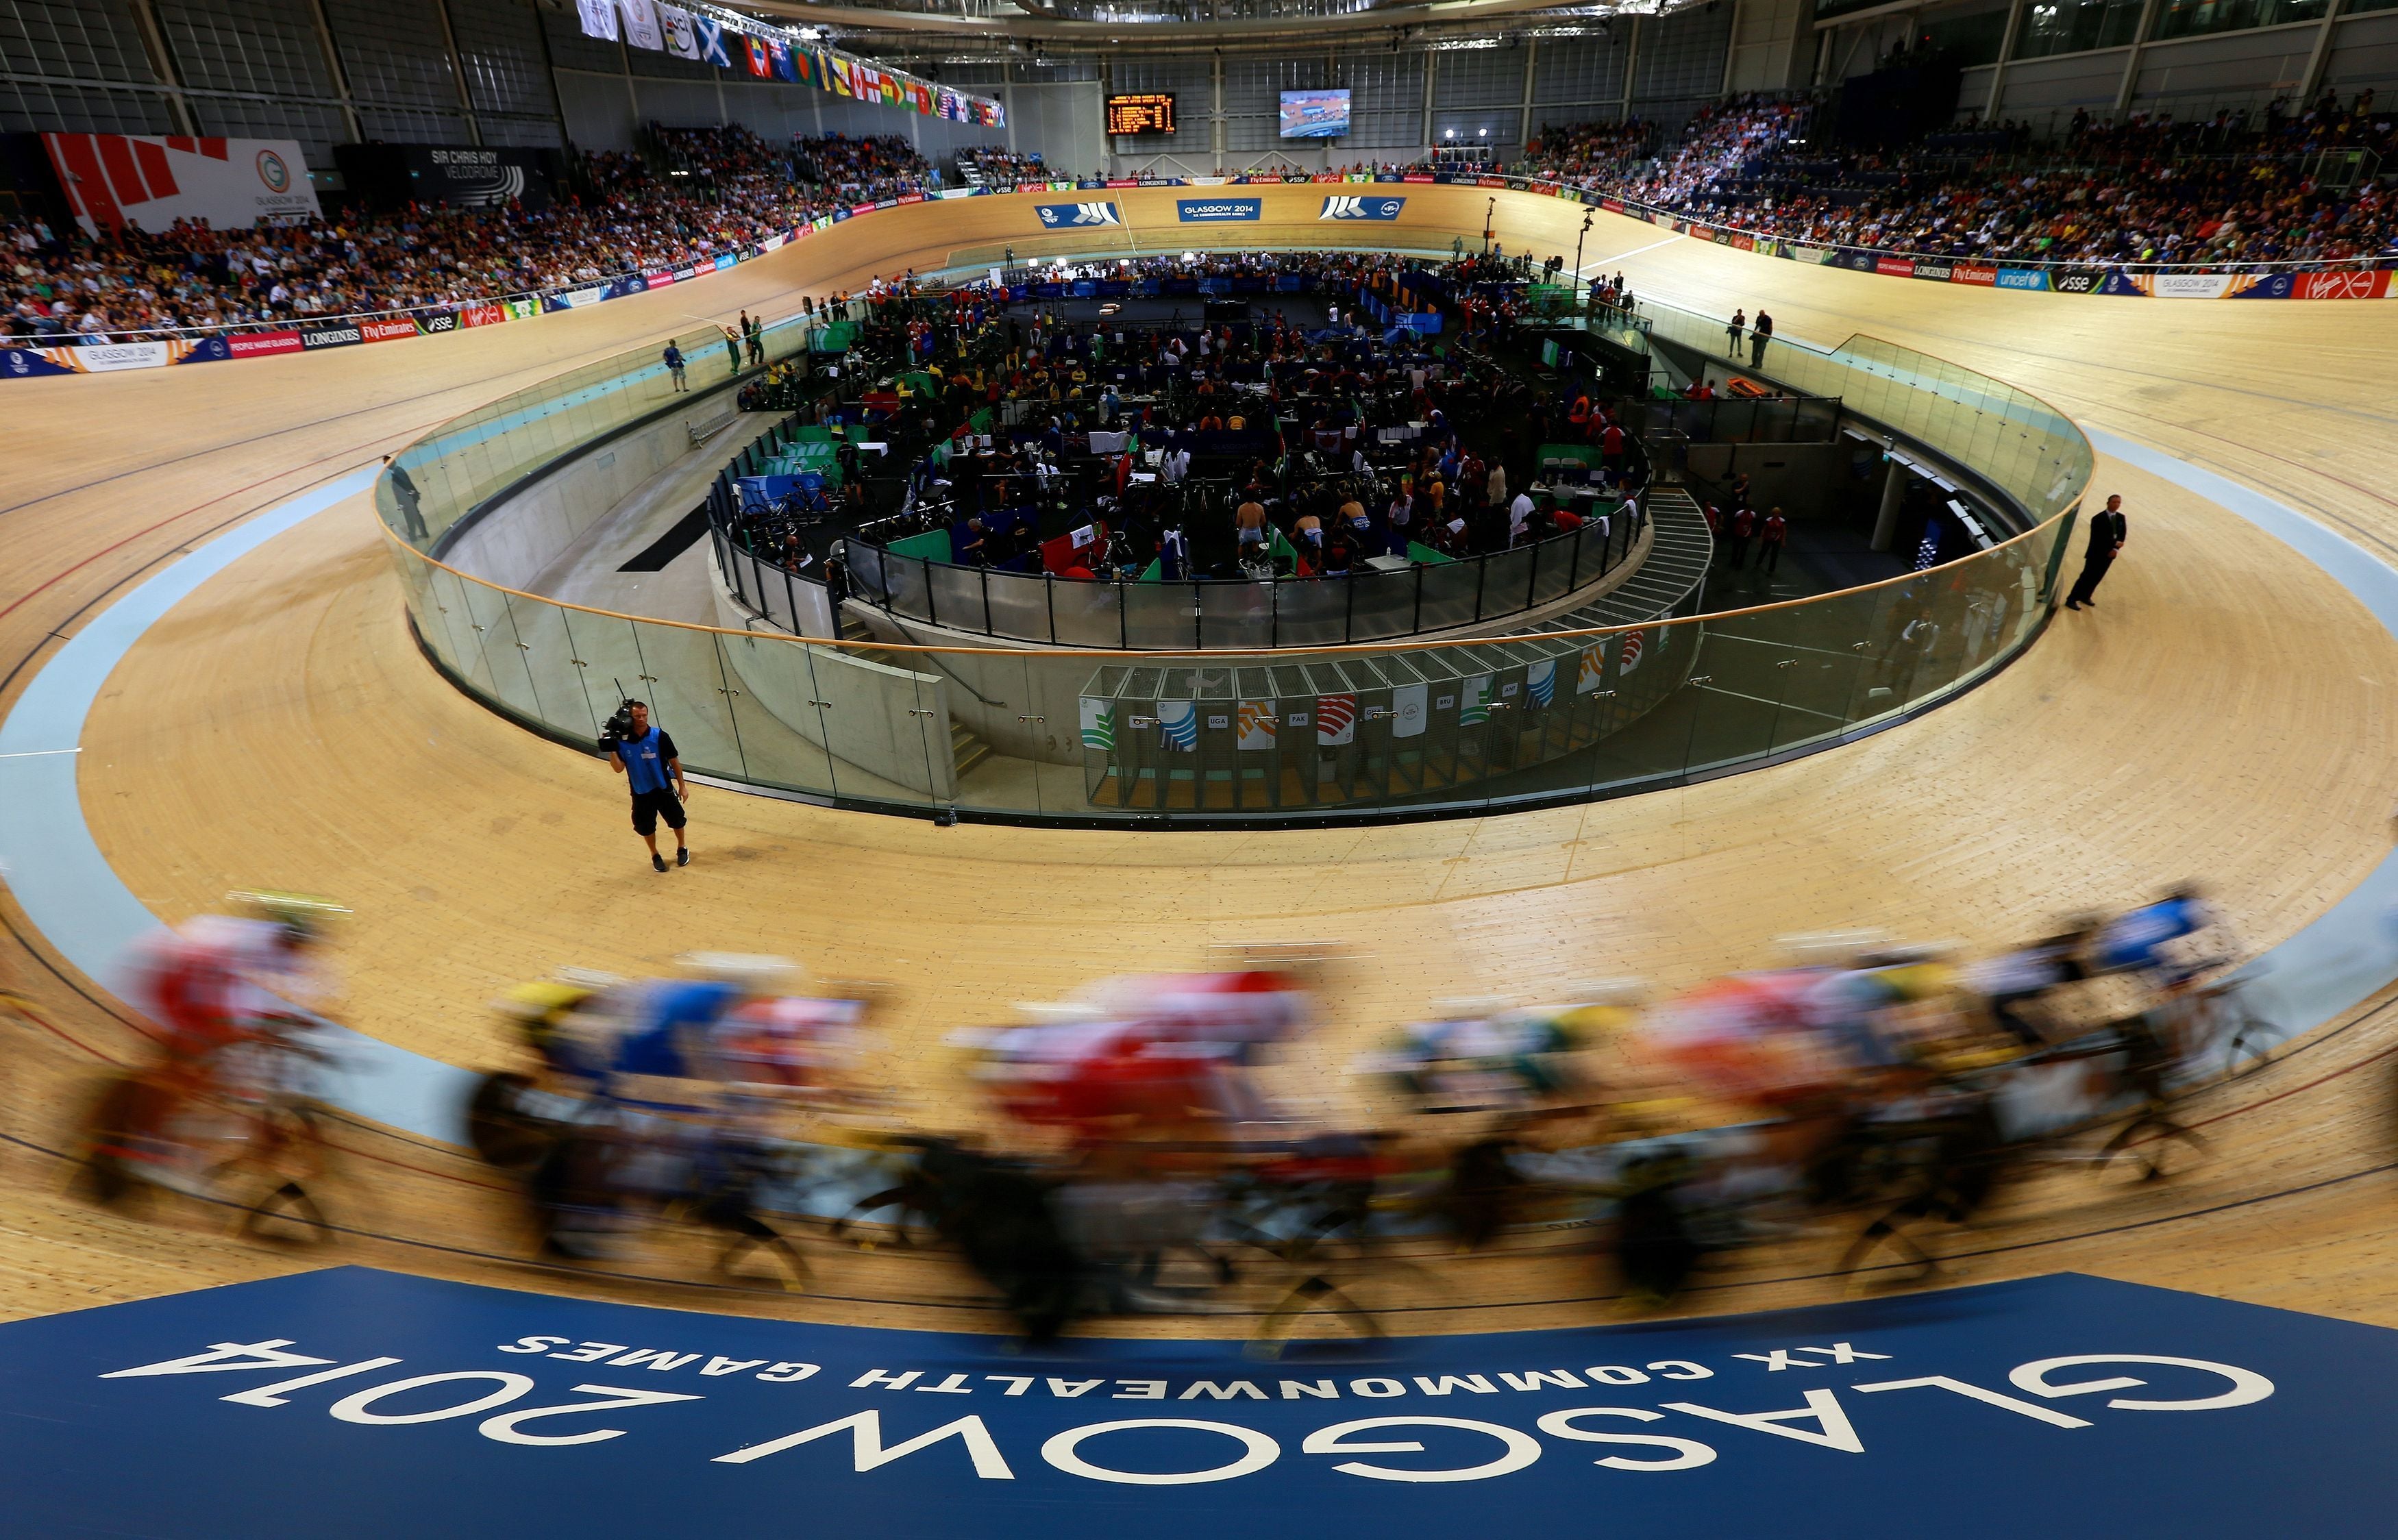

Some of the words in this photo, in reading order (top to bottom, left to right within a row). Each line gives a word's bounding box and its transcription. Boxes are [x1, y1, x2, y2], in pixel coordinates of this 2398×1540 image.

[432, 151, 449, 164] SIR
[450, 151, 478, 164] CHRIS
[479, 151, 497, 164] HOY
[443, 165, 499, 178] VELODROME
[1185, 206, 1232, 214] GLASGOW
[1914, 265, 1951, 278] LONGINES
[1953, 269, 1964, 280] Fly
[1965, 269, 1995, 282] Emirates
[2001, 273, 2029, 286] unicef
[2066, 277, 2089, 290] sse
[2163, 279, 2200, 288] GLASGOW
[2202, 279, 2219, 288] 2014
[434, 316, 454, 330] sse
[303, 329, 361, 346] LONGINES
[362, 326, 380, 340] Fly
[380, 323, 415, 336] Emirates
[230, 342, 255, 351] PEOPLE
[271, 338, 300, 347] GLASGOW
[89, 348, 135, 360] GLASGOW
[137, 347, 157, 356] 2014
[497, 1337, 821, 1382] GAMES
[1731, 1343, 1892, 1371] XX
[848, 1361, 1714, 1399] COMMONWEALTH
[98, 1339, 706, 1445] 2014
[710, 1354, 2274, 1485] GLASGOW
